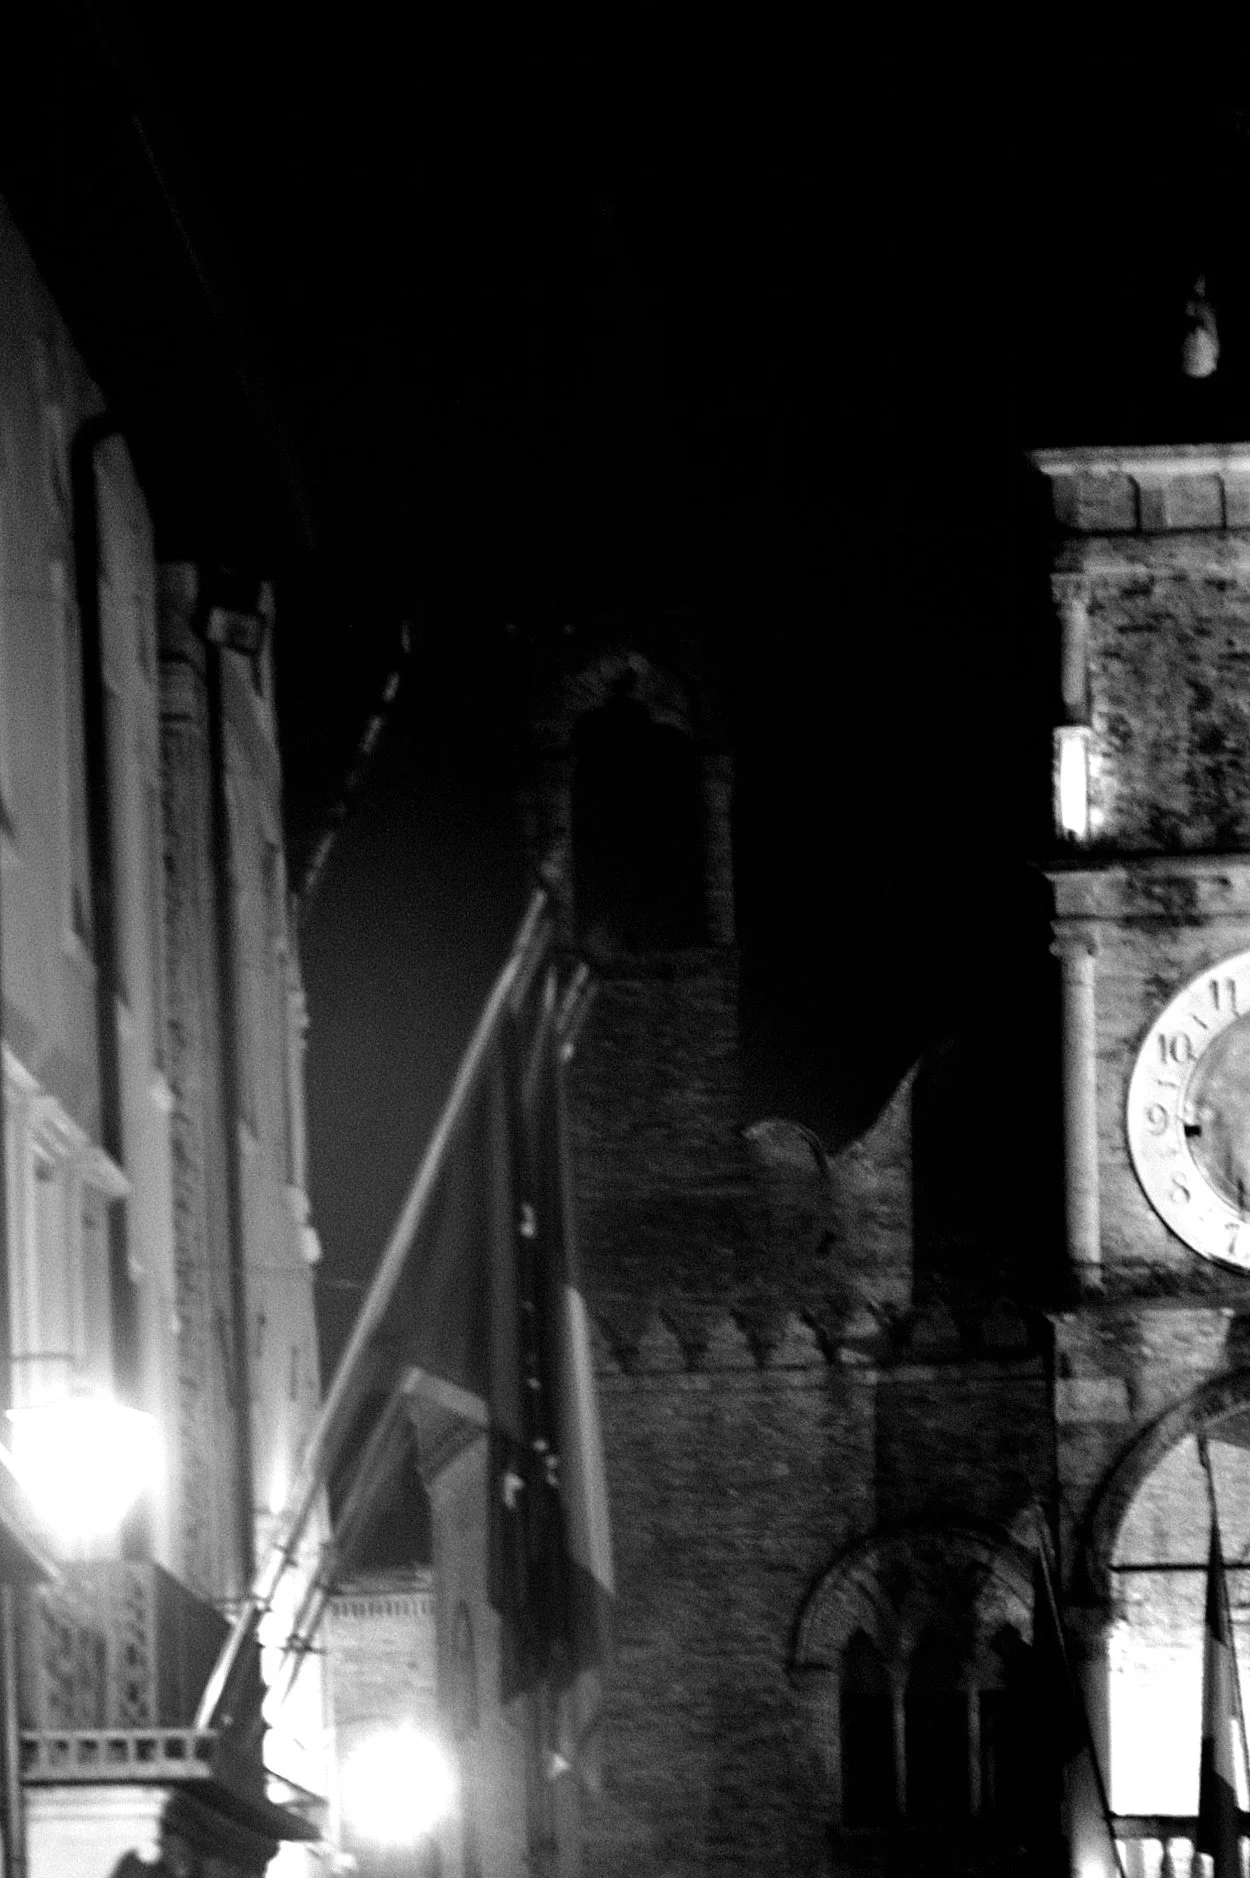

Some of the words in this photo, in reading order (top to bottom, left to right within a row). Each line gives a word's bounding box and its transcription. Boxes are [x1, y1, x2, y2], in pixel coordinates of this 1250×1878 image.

[1209, 977, 1237, 1011] 11
[1157, 1032, 1195, 1064] 10
[1143, 1102, 1168, 1137] 9
